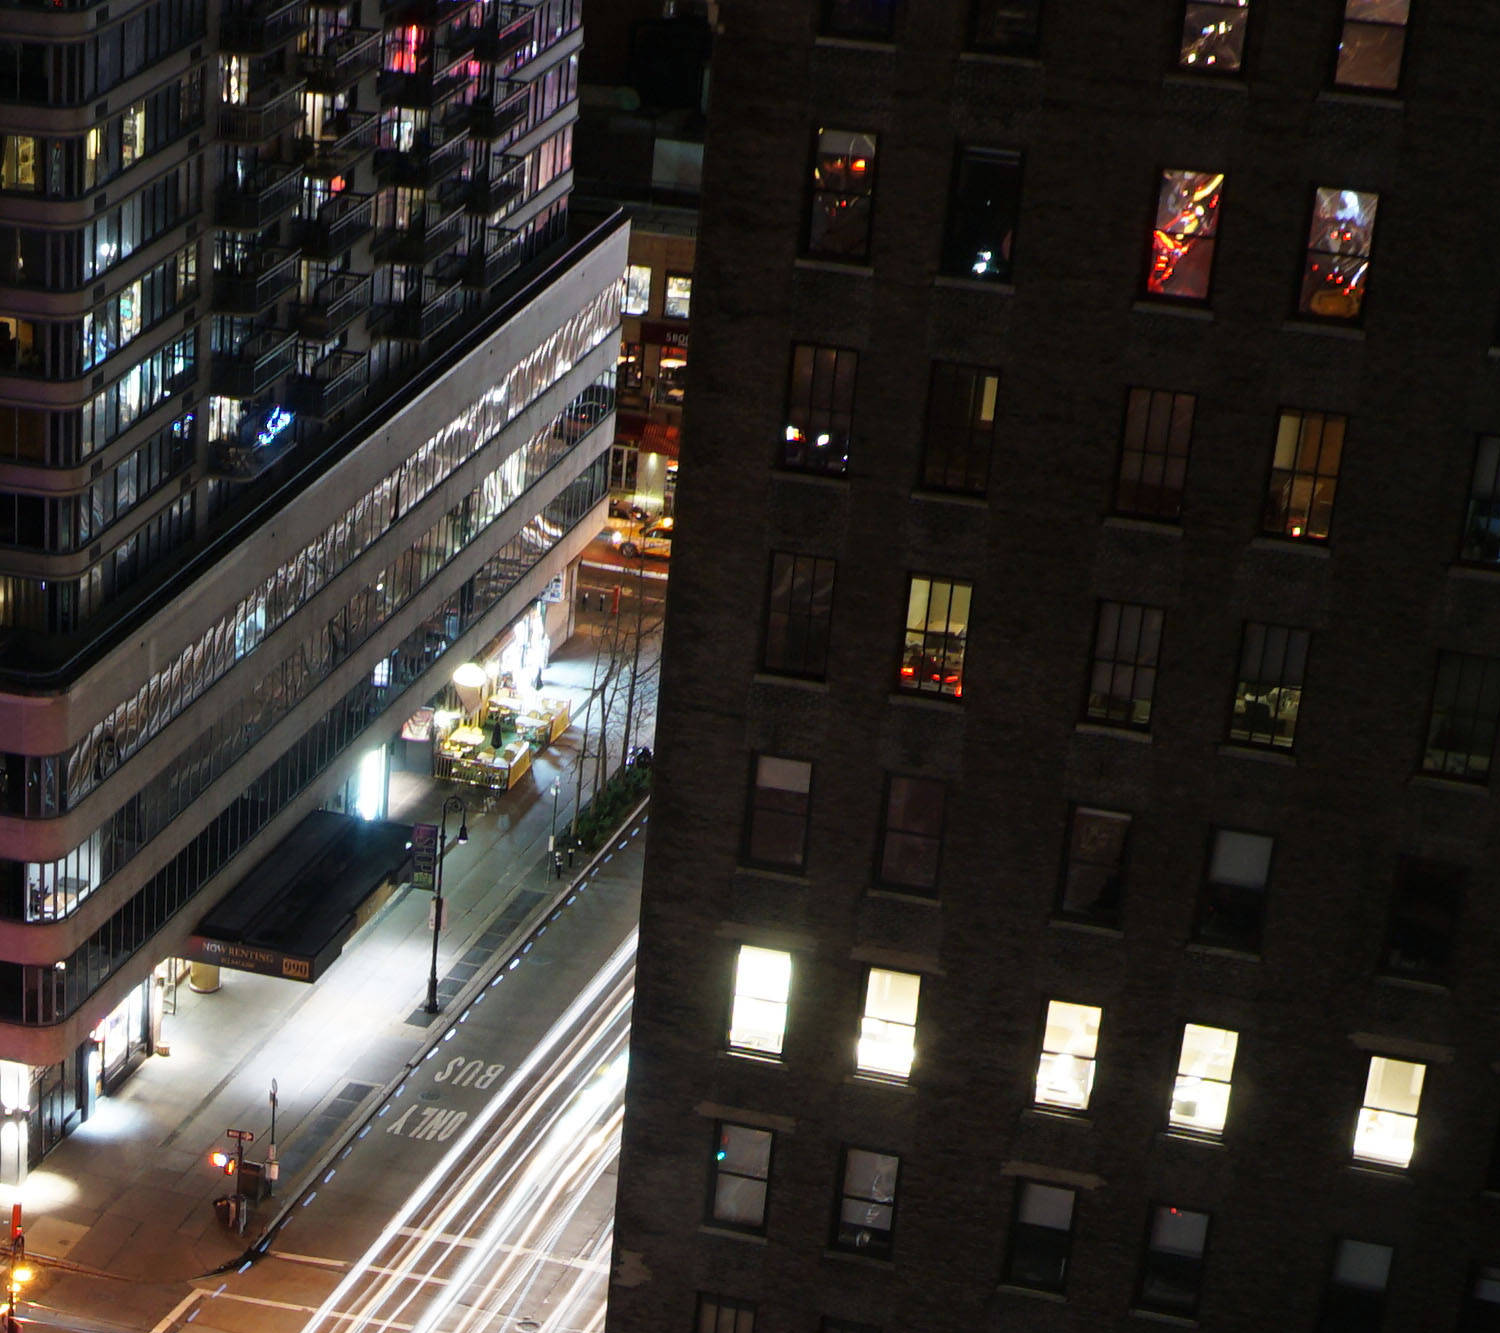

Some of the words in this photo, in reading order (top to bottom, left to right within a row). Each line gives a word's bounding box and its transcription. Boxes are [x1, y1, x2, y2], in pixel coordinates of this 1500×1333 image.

[202, 942, 226, 953] NOW
[229, 947, 273, 963] RENTING
[285, 960, 307, 976] 990
[434, 1056, 505, 1090] BUS
[386, 1104, 468, 1142] ONLY
